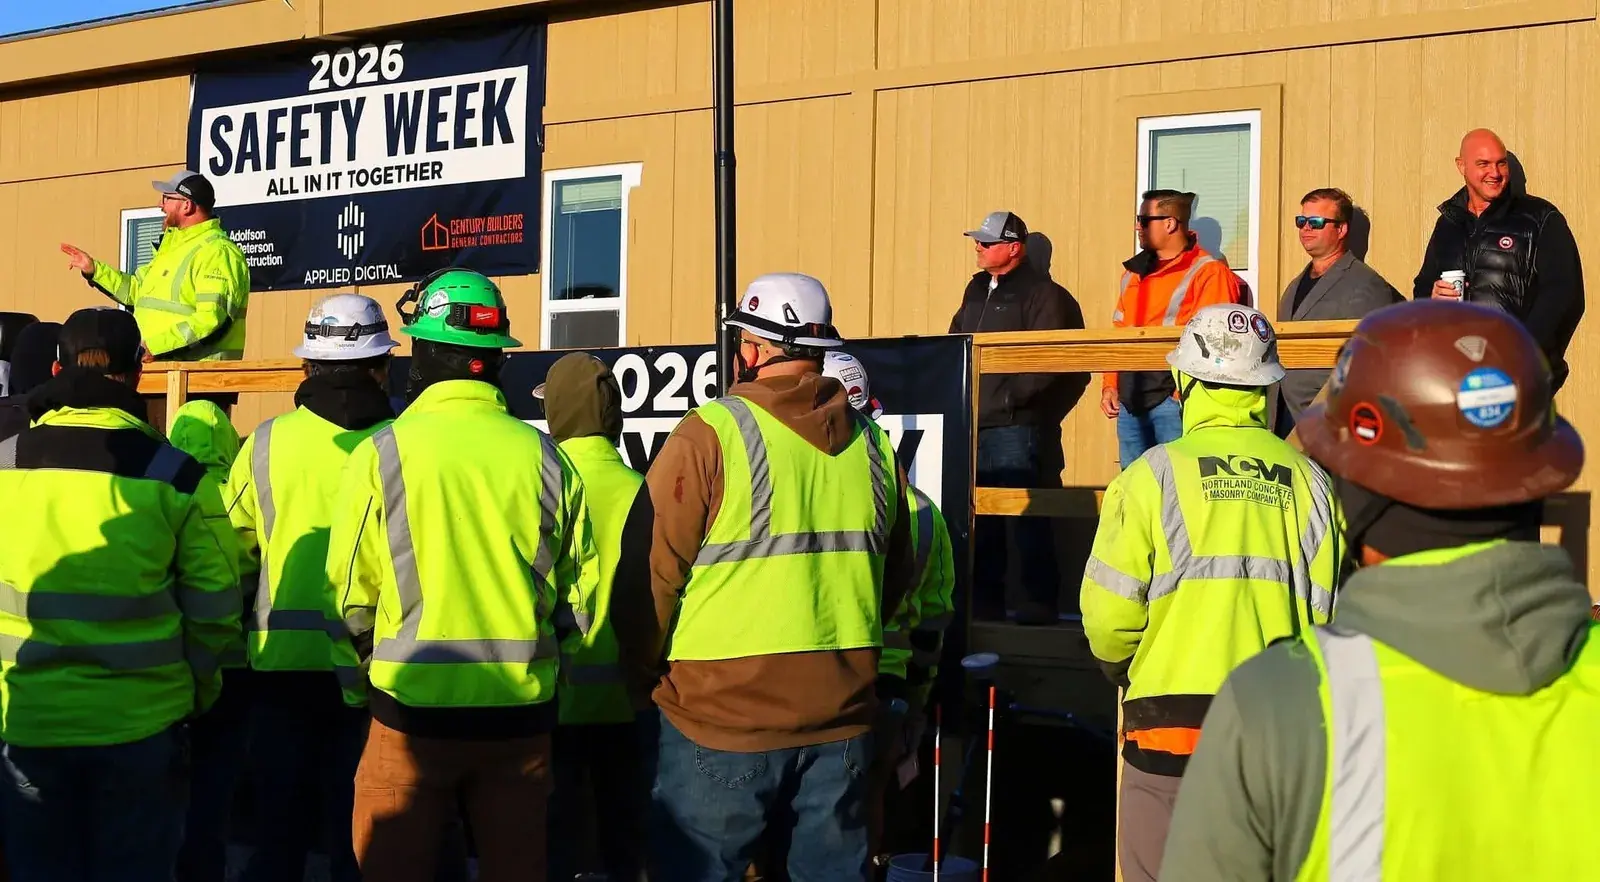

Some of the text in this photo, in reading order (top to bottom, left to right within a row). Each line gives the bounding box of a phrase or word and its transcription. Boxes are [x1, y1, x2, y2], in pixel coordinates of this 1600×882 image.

[308, 41, 404, 91] 2026
[209, 77, 518, 176] SAFETY WEEK
[266, 161, 444, 196] ALL IN IT TOGETHER
[229, 228, 266, 242] Adolfson
[451, 214, 524, 235] CENTURY BUILDERS
[451, 233, 523, 248] GENERAL CONTRACTORS
[246, 254, 283, 267] struction
[304, 264, 402, 285] APPLIED DIGITAL
[612, 350, 717, 413] 026
[1198, 455, 1292, 487] NCM
[1202, 479, 1292, 501] NORTHLAND CONCRETE
[1209, 489, 1245, 499] MASONRY
[1247, 490, 1278, 505] COMPANY
